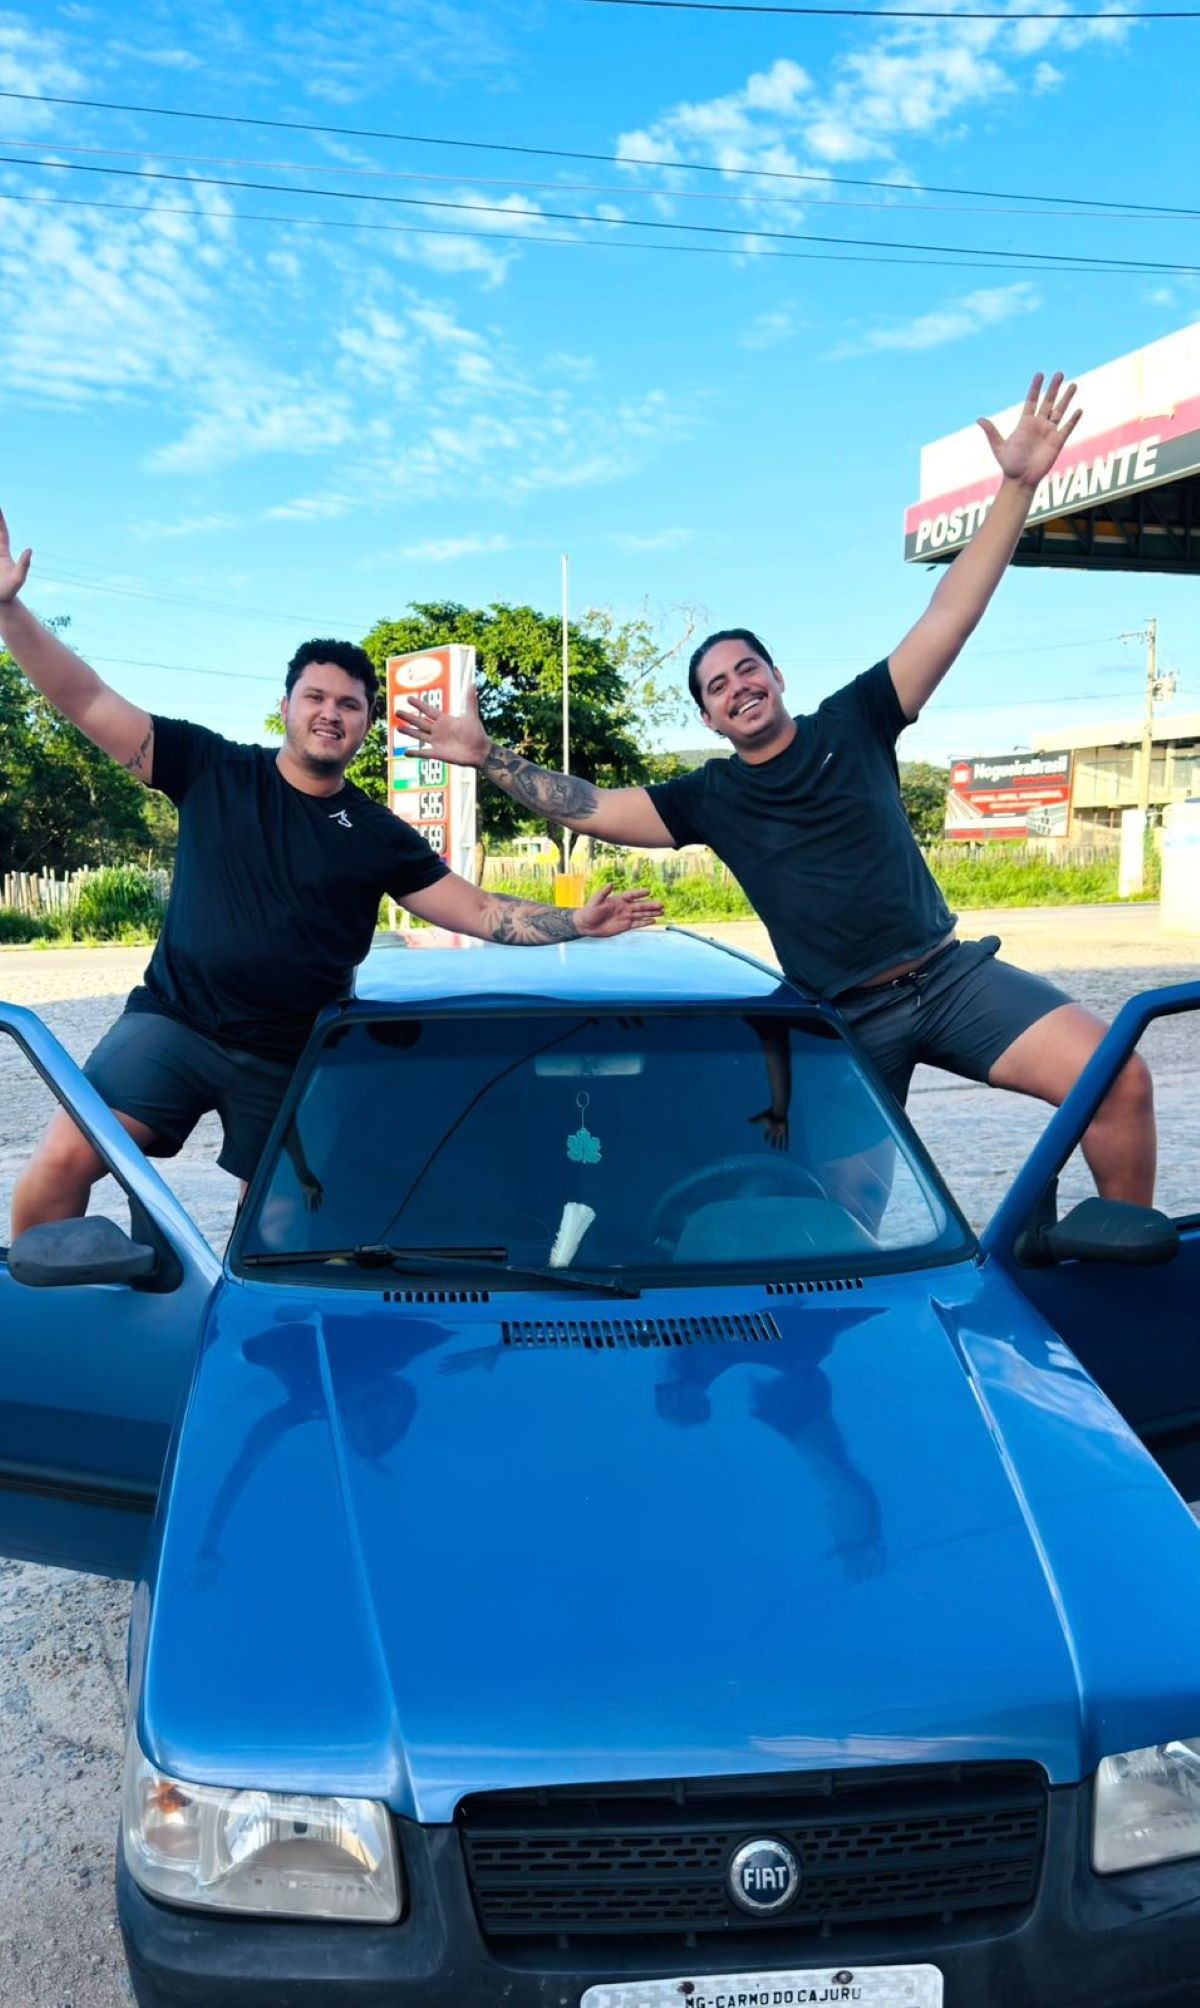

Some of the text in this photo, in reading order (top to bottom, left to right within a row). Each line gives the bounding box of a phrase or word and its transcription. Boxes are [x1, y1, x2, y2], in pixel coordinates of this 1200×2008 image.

[744, 1866, 786, 1890] FIAT
[773, 1990, 793, 2004] DO
[797, 1988, 861, 2002] CAJURU
